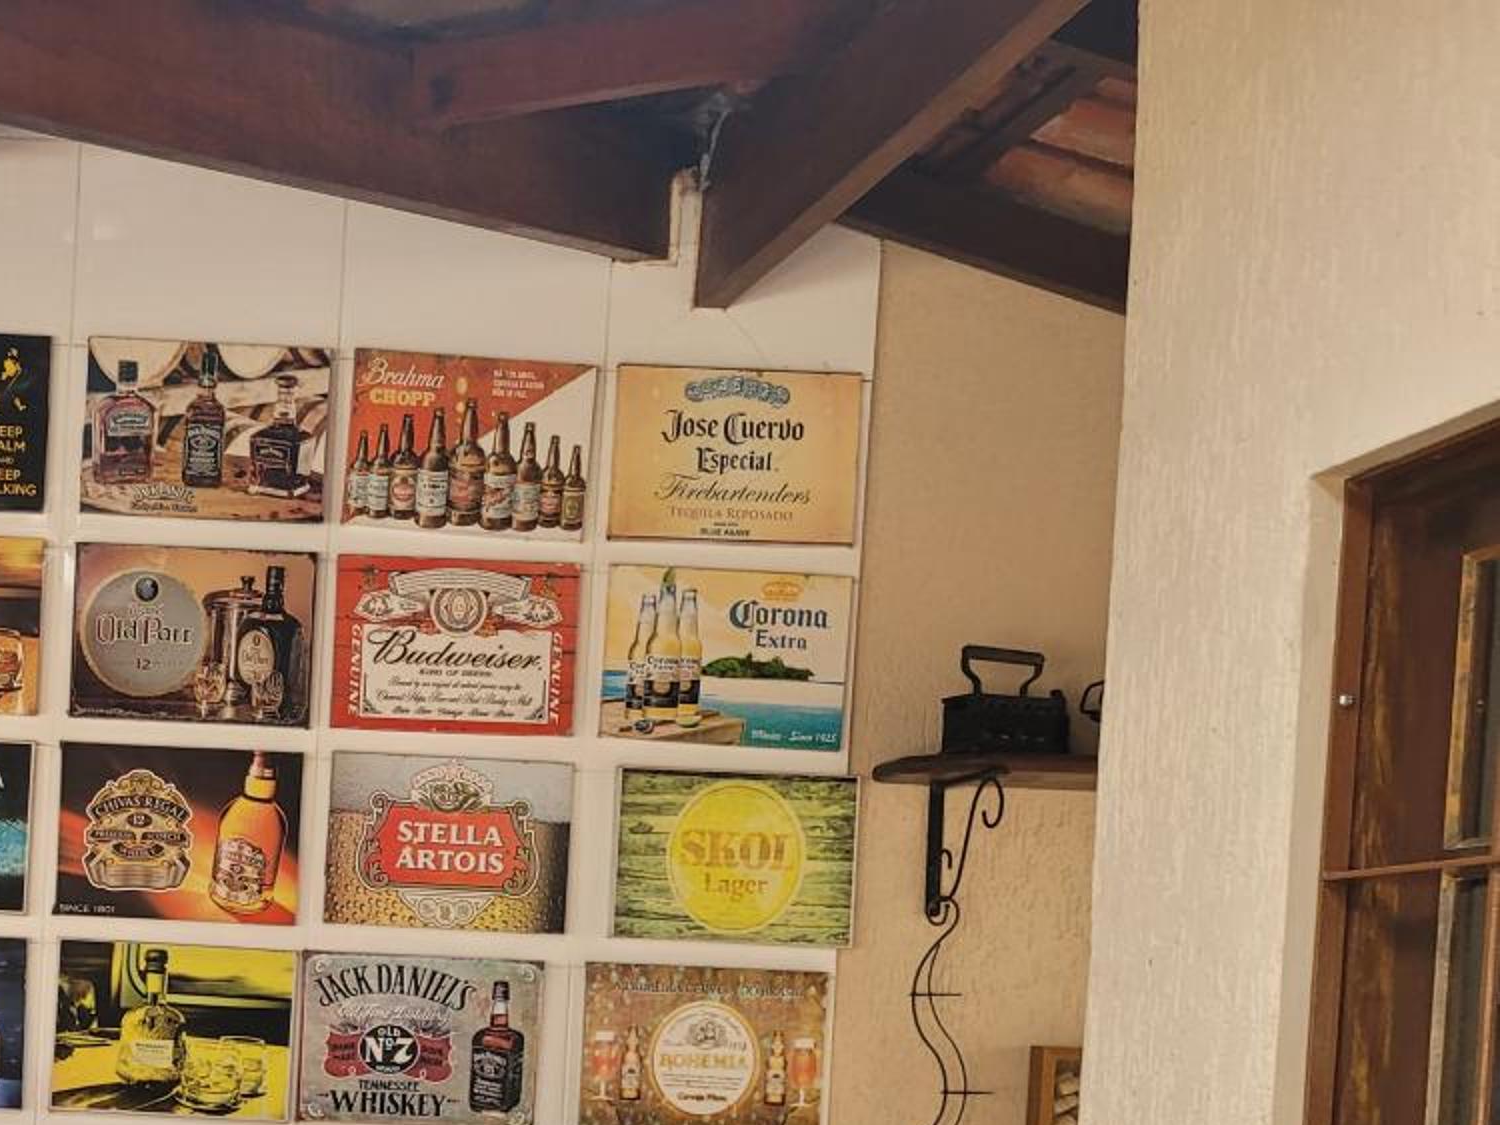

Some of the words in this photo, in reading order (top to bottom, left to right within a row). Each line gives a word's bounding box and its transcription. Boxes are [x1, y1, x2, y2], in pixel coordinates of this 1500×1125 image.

[364, 357, 445, 389] Brahma
[370, 387, 436, 407] CHOPP
[660, 409, 719, 443] Jose
[723, 412, 805, 445] Cuervo
[695, 447, 773, 475] Especial
[729, 599, 828, 630] Corona
[97, 613, 137, 645] Old
[138, 614, 193, 647] Parr
[755, 629, 807, 650] Extra
[367, 628, 540, 671] Budweiser
[347, 622, 363, 718] GENUINE
[550, 631, 564, 727] GENUINE
[95, 796, 141, 817] CHIVAS
[396, 820, 503, 847] STELLA
[395, 848, 505, 875] ARTOIS
[680, 830, 794, 872] SKOL
[704, 873, 770, 901] Lager
[314, 966, 373, 1007] JACK
[359, 1080, 420, 1093] TENNESSEE
[330, 1091, 447, 1117] WHISKEY
